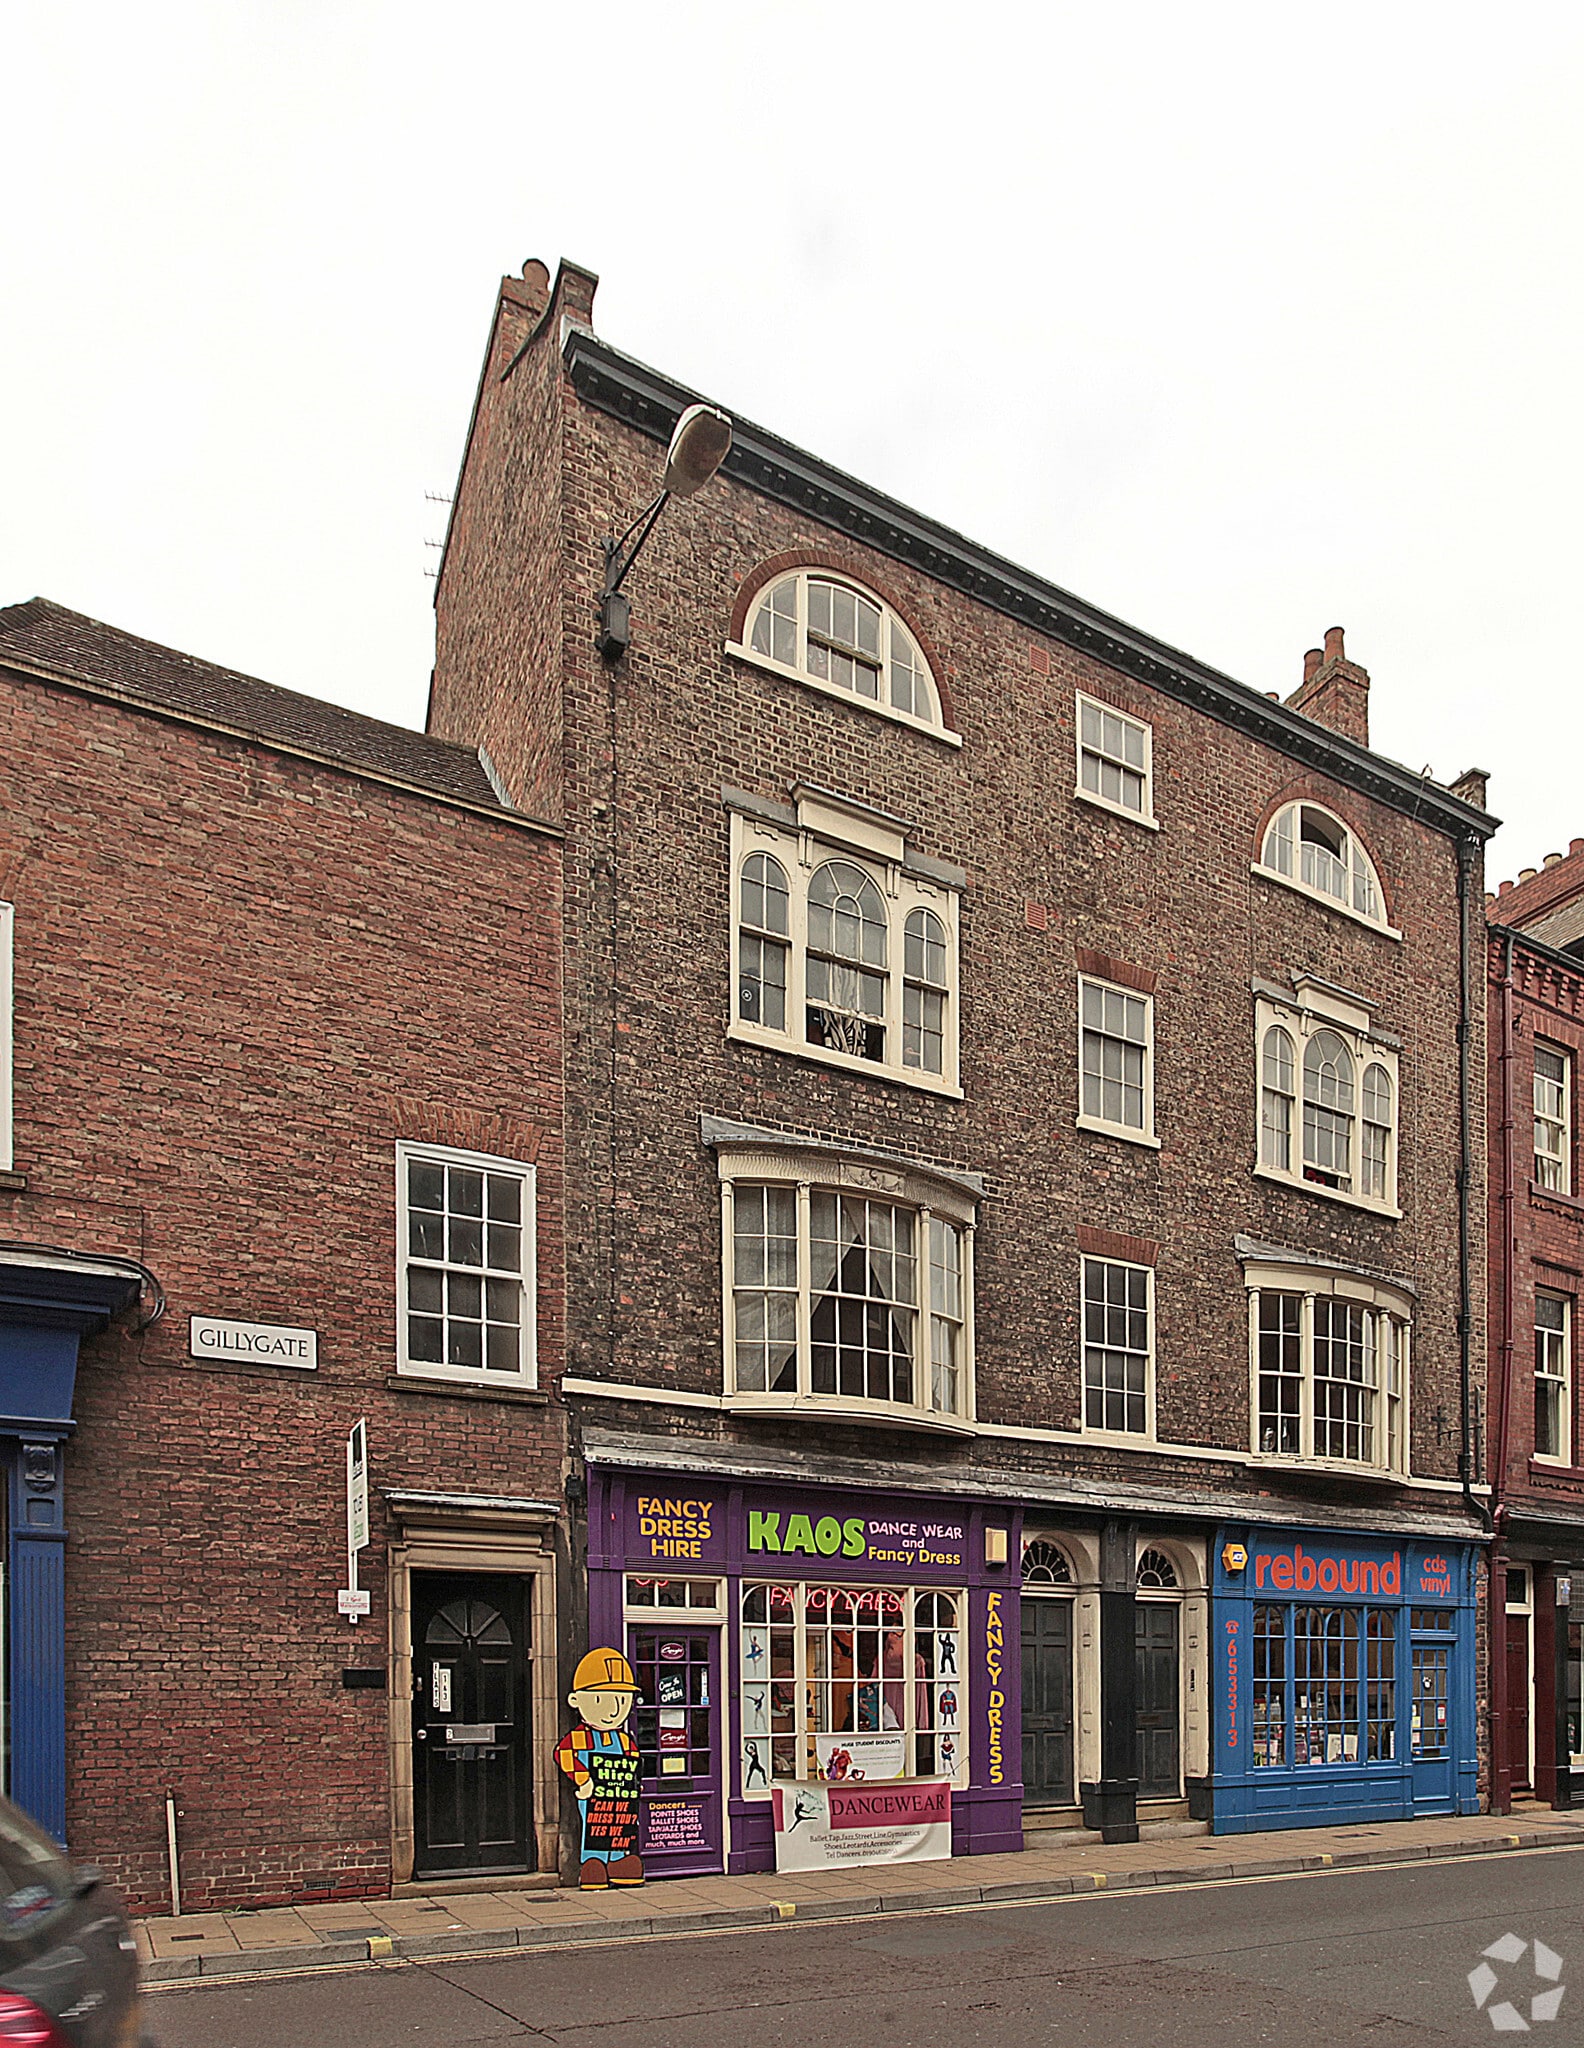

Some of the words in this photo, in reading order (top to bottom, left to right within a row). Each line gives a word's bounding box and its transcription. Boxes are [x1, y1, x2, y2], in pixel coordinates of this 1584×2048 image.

[199, 1328, 309, 1357] GILLYGATE
[638, 1497, 713, 1519] FANCY
[640, 1517, 712, 1539] DRESS
[749, 1511, 866, 1557] KAOS
[868, 1521, 918, 1537] DANCE
[922, 1524, 963, 1540] WEAR
[651, 1538, 702, 1558] HIRE
[902, 1537, 925, 1548] and
[868, 1547, 915, 1566] Fancy
[919, 1549, 961, 1565] Dress
[1423, 1554, 1447, 1574] cds
[1255, 1543, 1400, 1595] rebound
[1420, 1574, 1451, 1597] vinyl
[986, 1591, 1004, 1686] FANCY
[661, 1689, 683, 1702] OPEN
[1227, 1638, 1239, 1747] 653313
[987, 1690, 1005, 1784] DRESS
[592, 1756, 638, 1772] Party
[598, 1768, 633, 1780] Hire
[594, 1786, 638, 1798] Sales
[615, 1801, 629, 1812] WE
[649, 1802, 686, 1810] Dancers
[676, 1809, 699, 1817] SHOES
[831, 1794, 945, 1816] DANCEWEAR
[587, 1812, 614, 1824] DRESS
[615, 1813, 638, 1825] YOU?
[676, 1816, 699, 1824] SHOES
[590, 1825, 607, 1836] YES
[609, 1825, 623, 1836] WE
[651, 1832, 685, 1840] LEOTARDS
[826, 1851, 836, 1859] Tel
